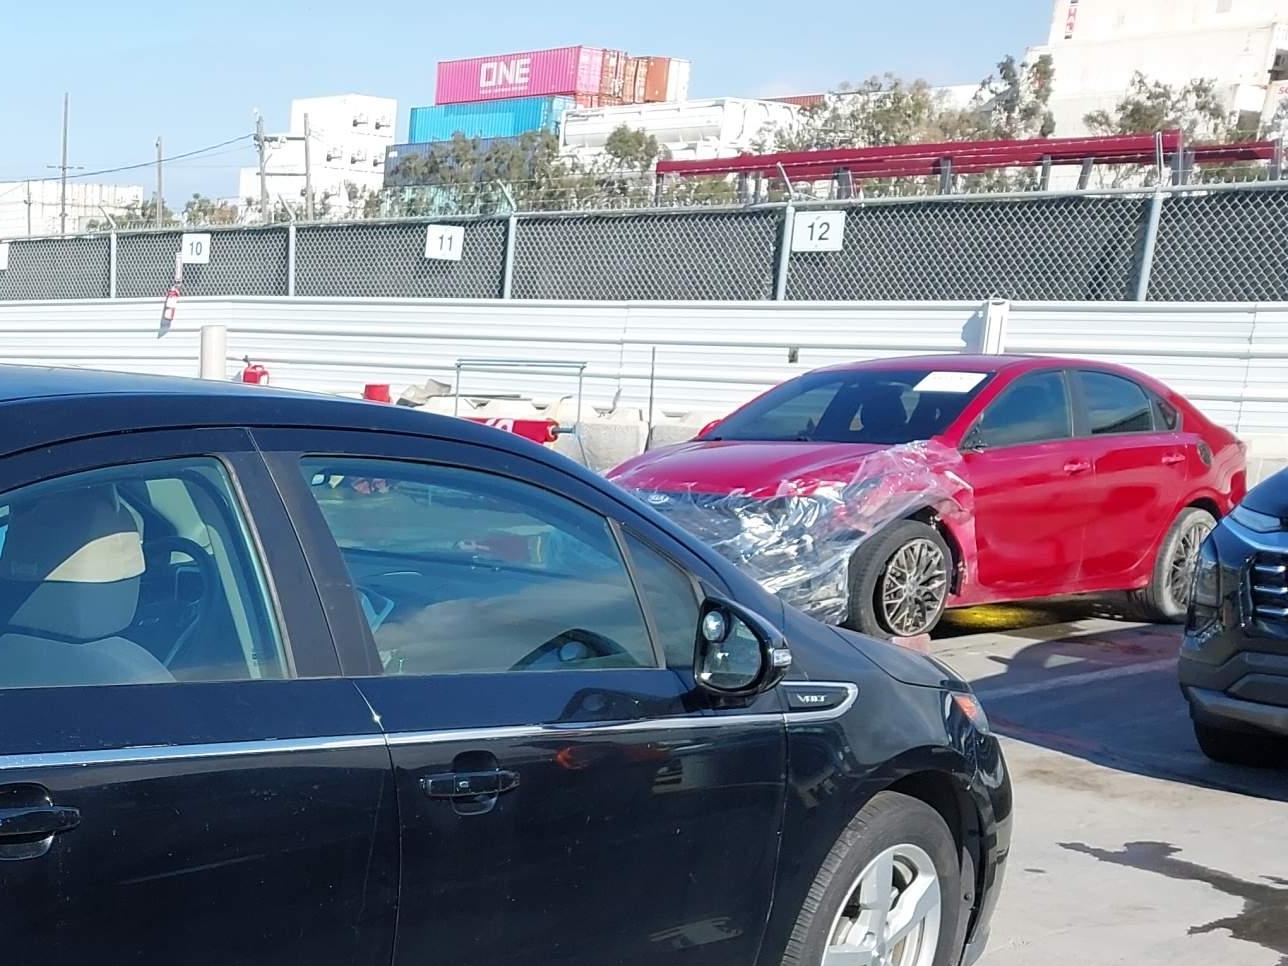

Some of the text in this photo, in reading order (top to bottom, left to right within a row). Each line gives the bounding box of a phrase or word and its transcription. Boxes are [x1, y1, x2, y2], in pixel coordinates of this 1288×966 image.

[479, 58, 531, 89] ONE
[808, 222, 830, 241] 12
[189, 241, 203, 256] 10
[439, 234, 453, 252] 11
